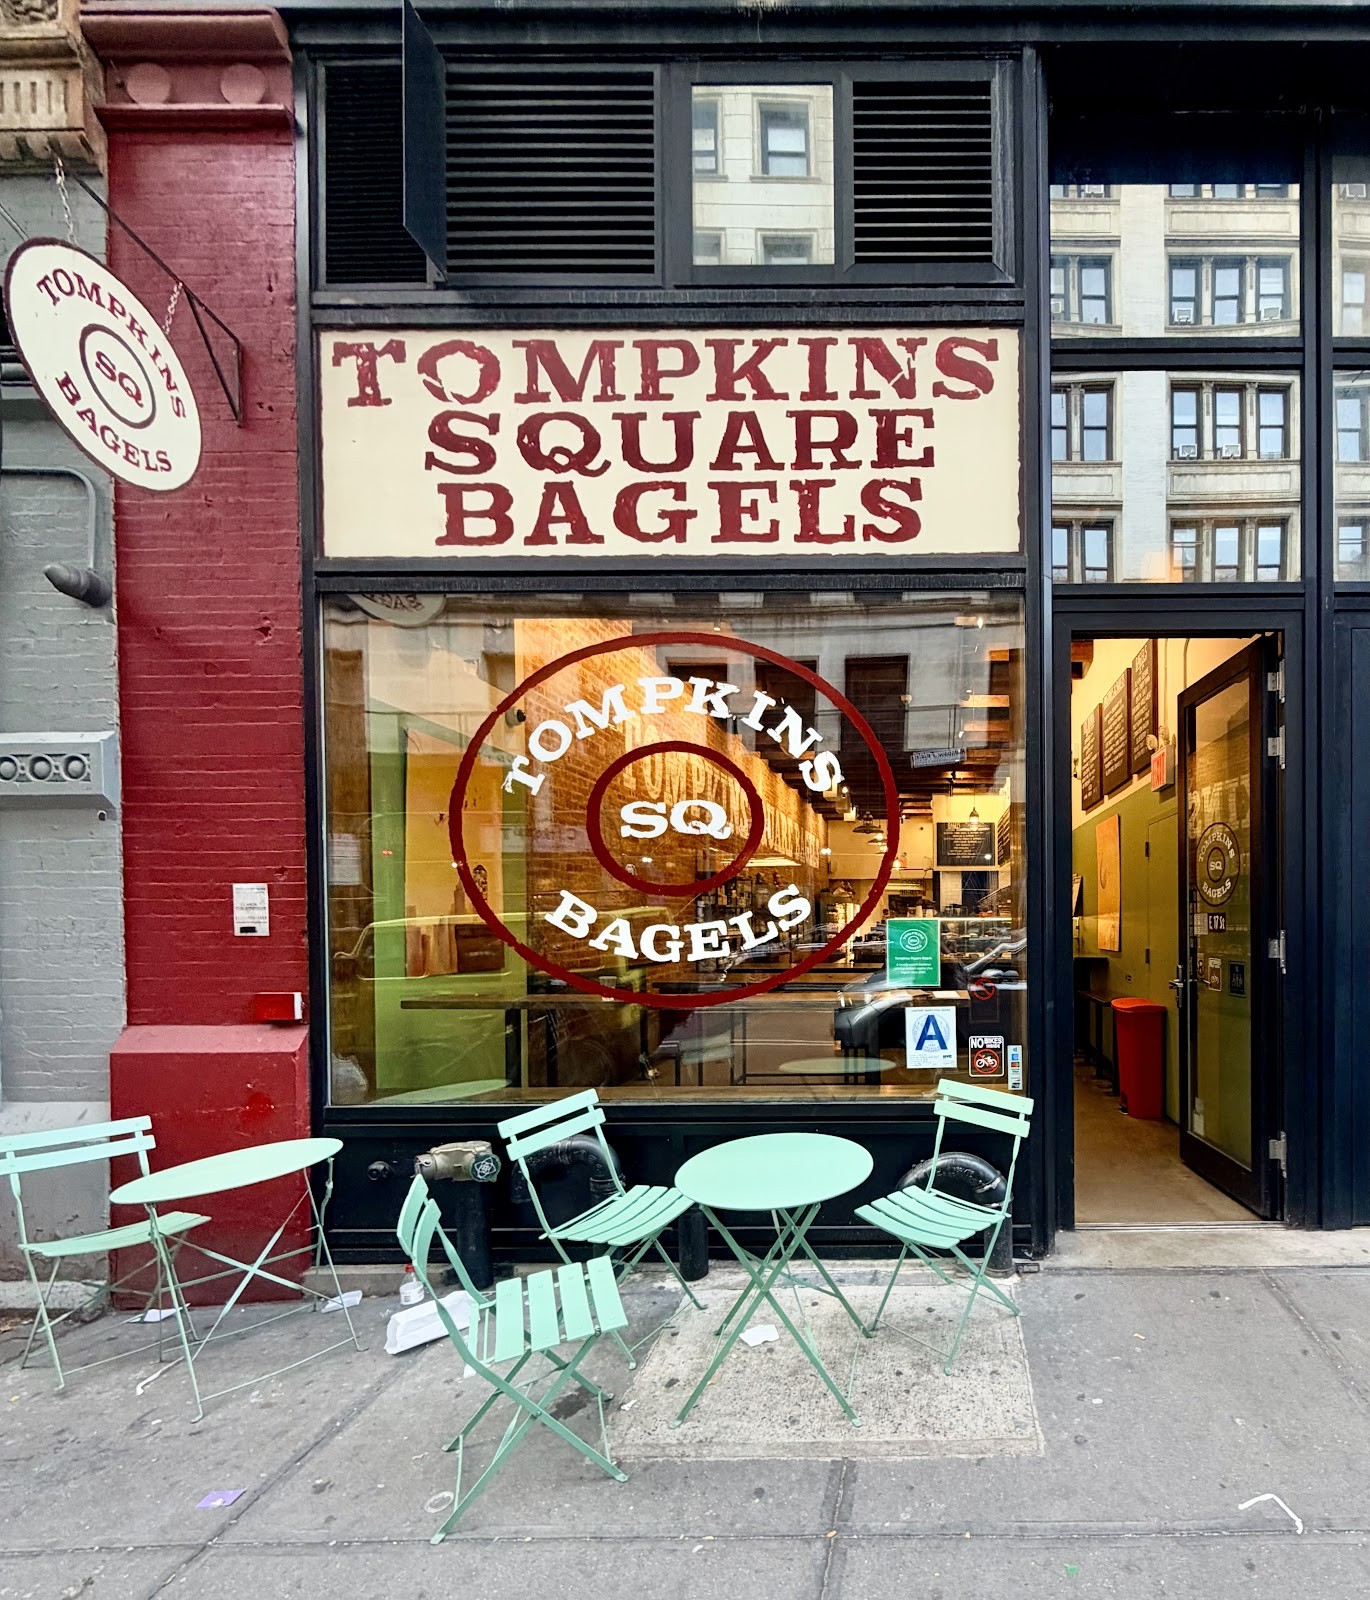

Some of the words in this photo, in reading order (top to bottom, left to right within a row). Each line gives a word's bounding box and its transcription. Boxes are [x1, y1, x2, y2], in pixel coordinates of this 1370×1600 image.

[36, 268, 186, 419] TOMPKINS
[332, 336, 1000, 407] TOMPKINS
[94, 350, 144, 408] SQ
[55, 371, 172, 473] BAGELS
[424, 407, 935, 477] SQUARE
[434, 477, 923, 547] BAGELS
[503, 675, 844, 798] TOMPKINS
[620, 799, 732, 841] SQ
[1199, 831, 1235, 862] TOMPKINS
[1202, 877, 1232, 899] BAGELS
[1209, 860, 1223, 871] SQ
[544, 883, 811, 963] BAGELS
[914, 1014, 948, 1051] A
[970, 1037, 984, 1048] NO
